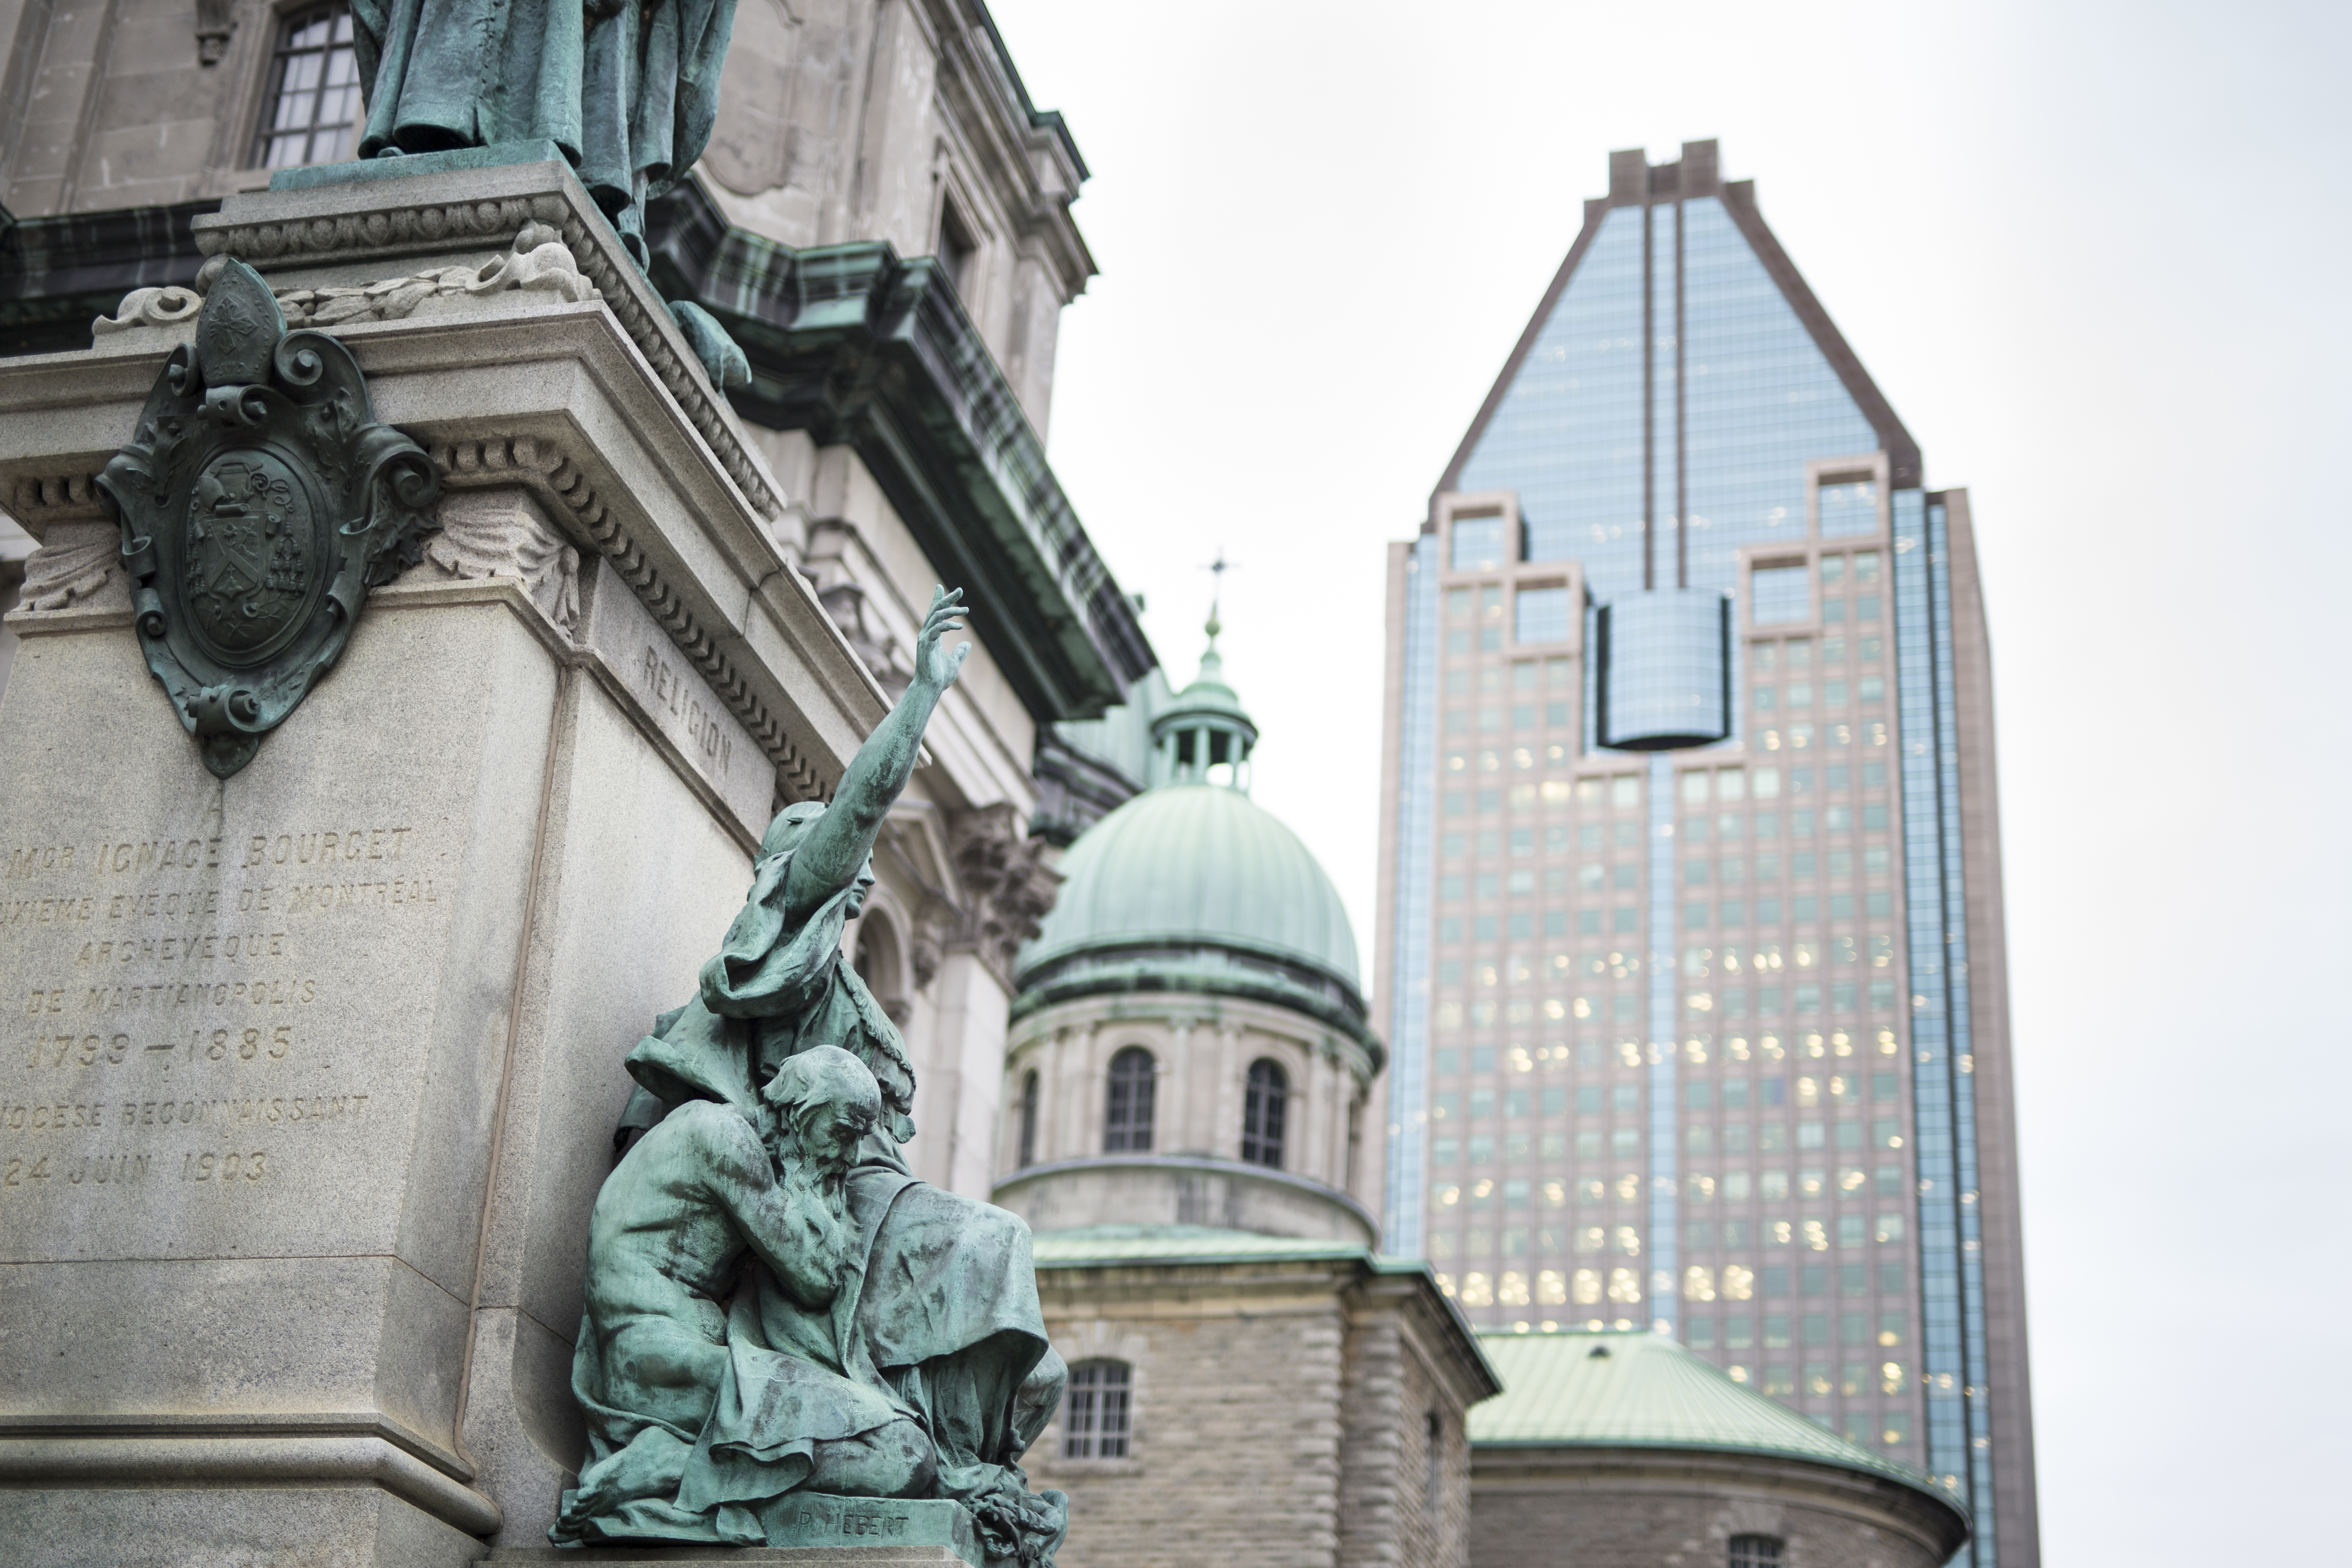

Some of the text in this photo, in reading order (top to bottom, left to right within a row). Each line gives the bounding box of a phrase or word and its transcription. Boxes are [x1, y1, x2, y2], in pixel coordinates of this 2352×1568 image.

[643, 645, 731, 774] RELIGION
[96, 839, 222, 875] IGNACE
[243, 827, 412, 868] BOURGET
[237, 886, 274, 912] DE
[27, 979, 315, 1015] DE MARTIANOPOLIS
[4, 1152, 266, 1186] 24 JUIN 1903
